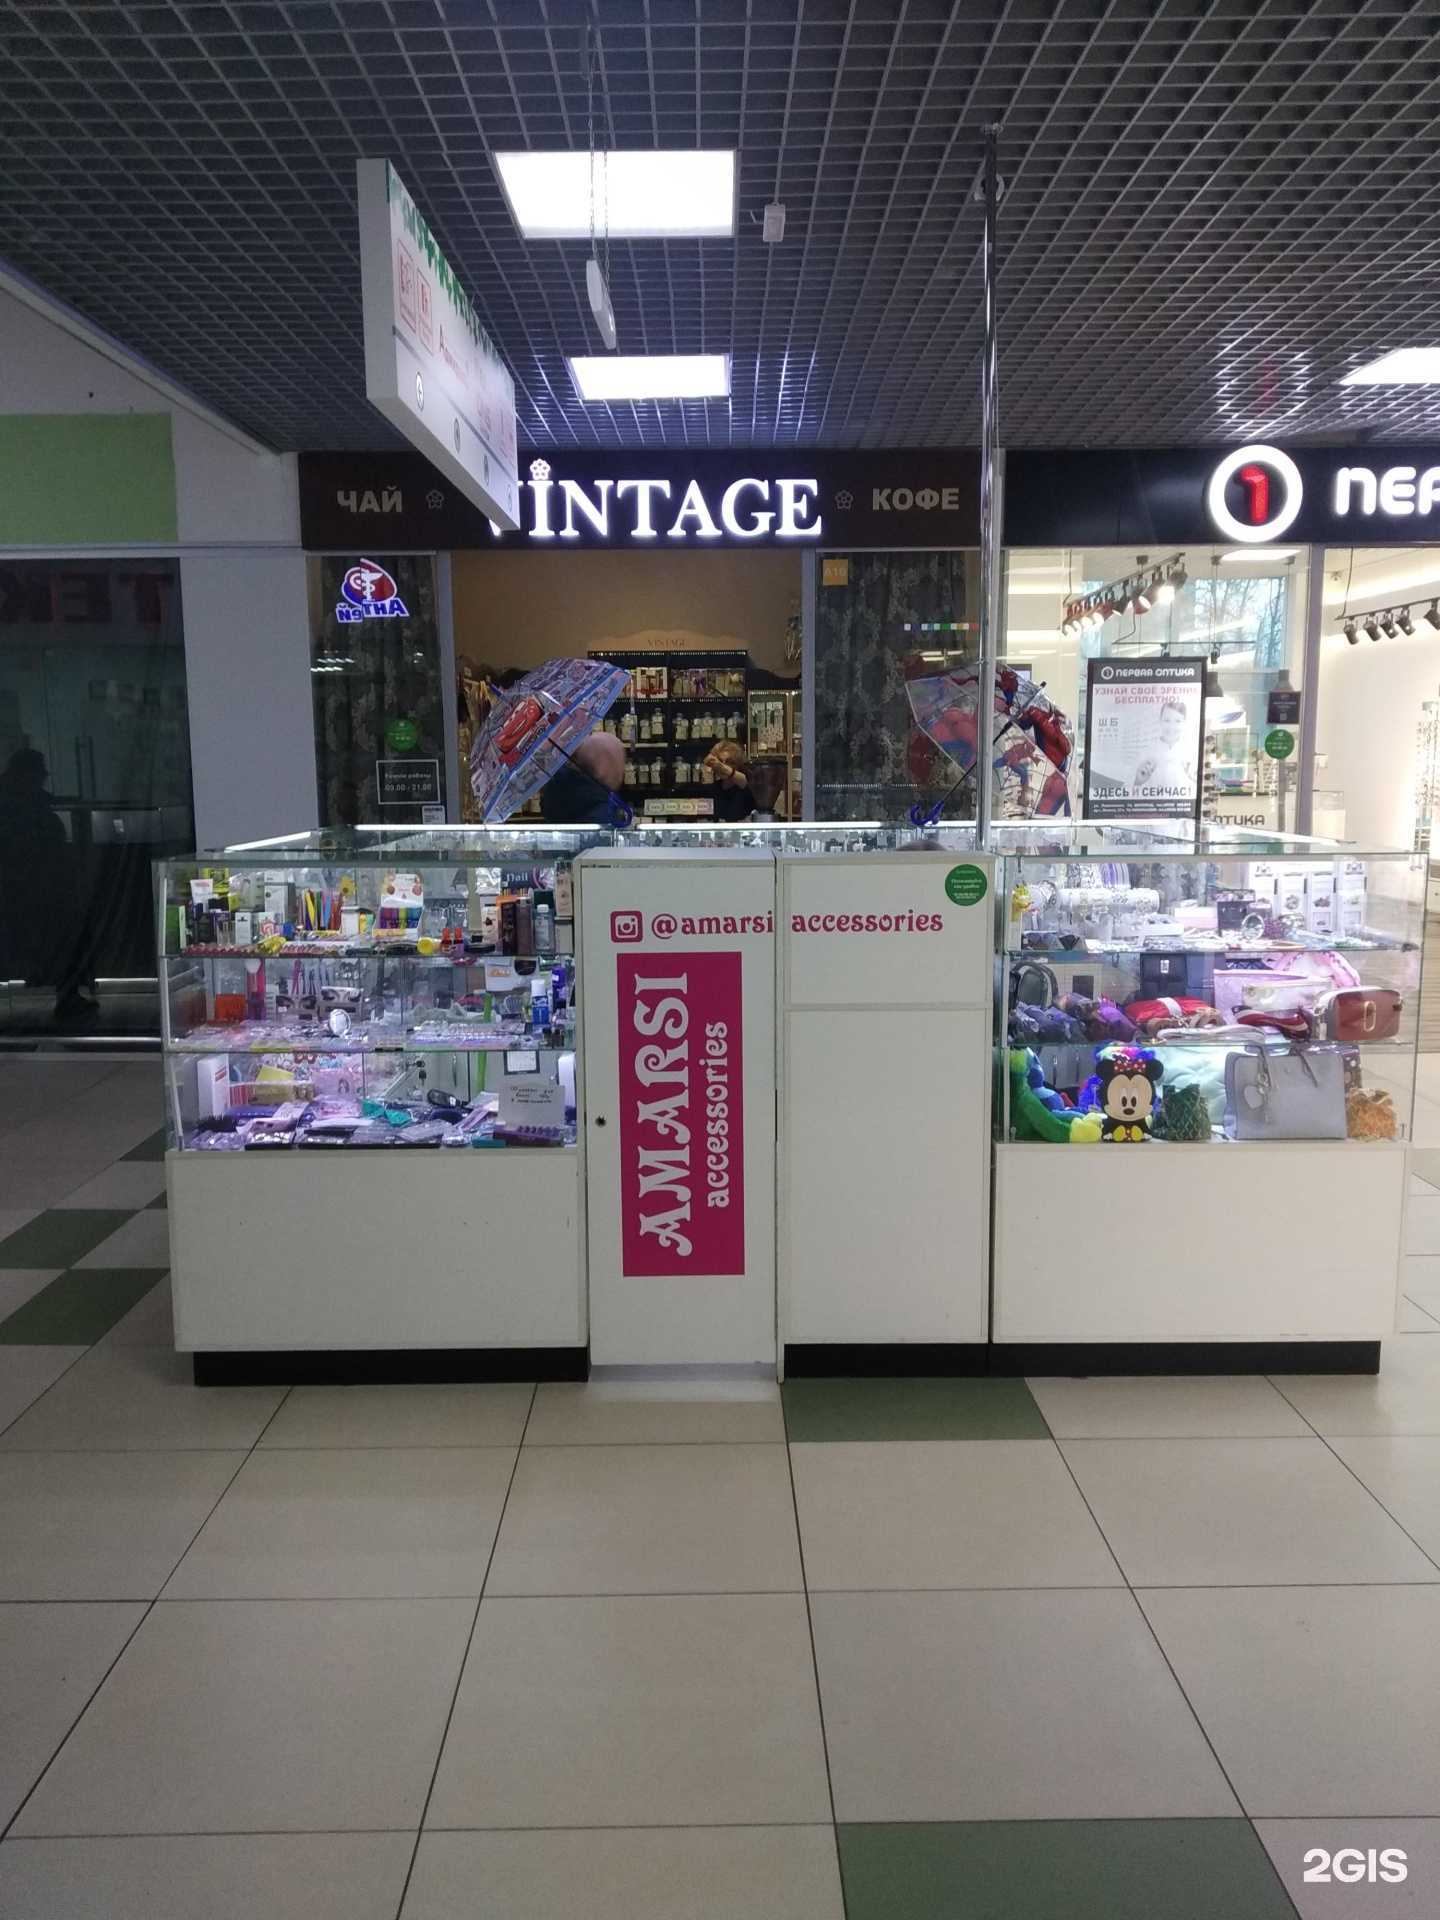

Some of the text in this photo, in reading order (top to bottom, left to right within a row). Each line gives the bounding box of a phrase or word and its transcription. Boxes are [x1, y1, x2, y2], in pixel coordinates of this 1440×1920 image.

[336, 486, 403, 513] ЧАЙ
[488, 478, 823, 538] INTAGE
[872, 487, 960, 511] КОФЕ
[1115, 667, 1195, 677] ПЕРВАЯ ОПТИКА
[1095, 686, 1127, 696] УЗНАЙ
[1093, 787, 1129, 798] ЗДЕСЬ
[1142, 786, 1192, 798] СЕЙЧАС!
[1214, 814, 1265, 826] ПТИКА
[651, 909, 943, 939] @amarsi accessories
[633, 972, 693, 1257] AMARSI
[699, 1021, 730, 1208] accessories
